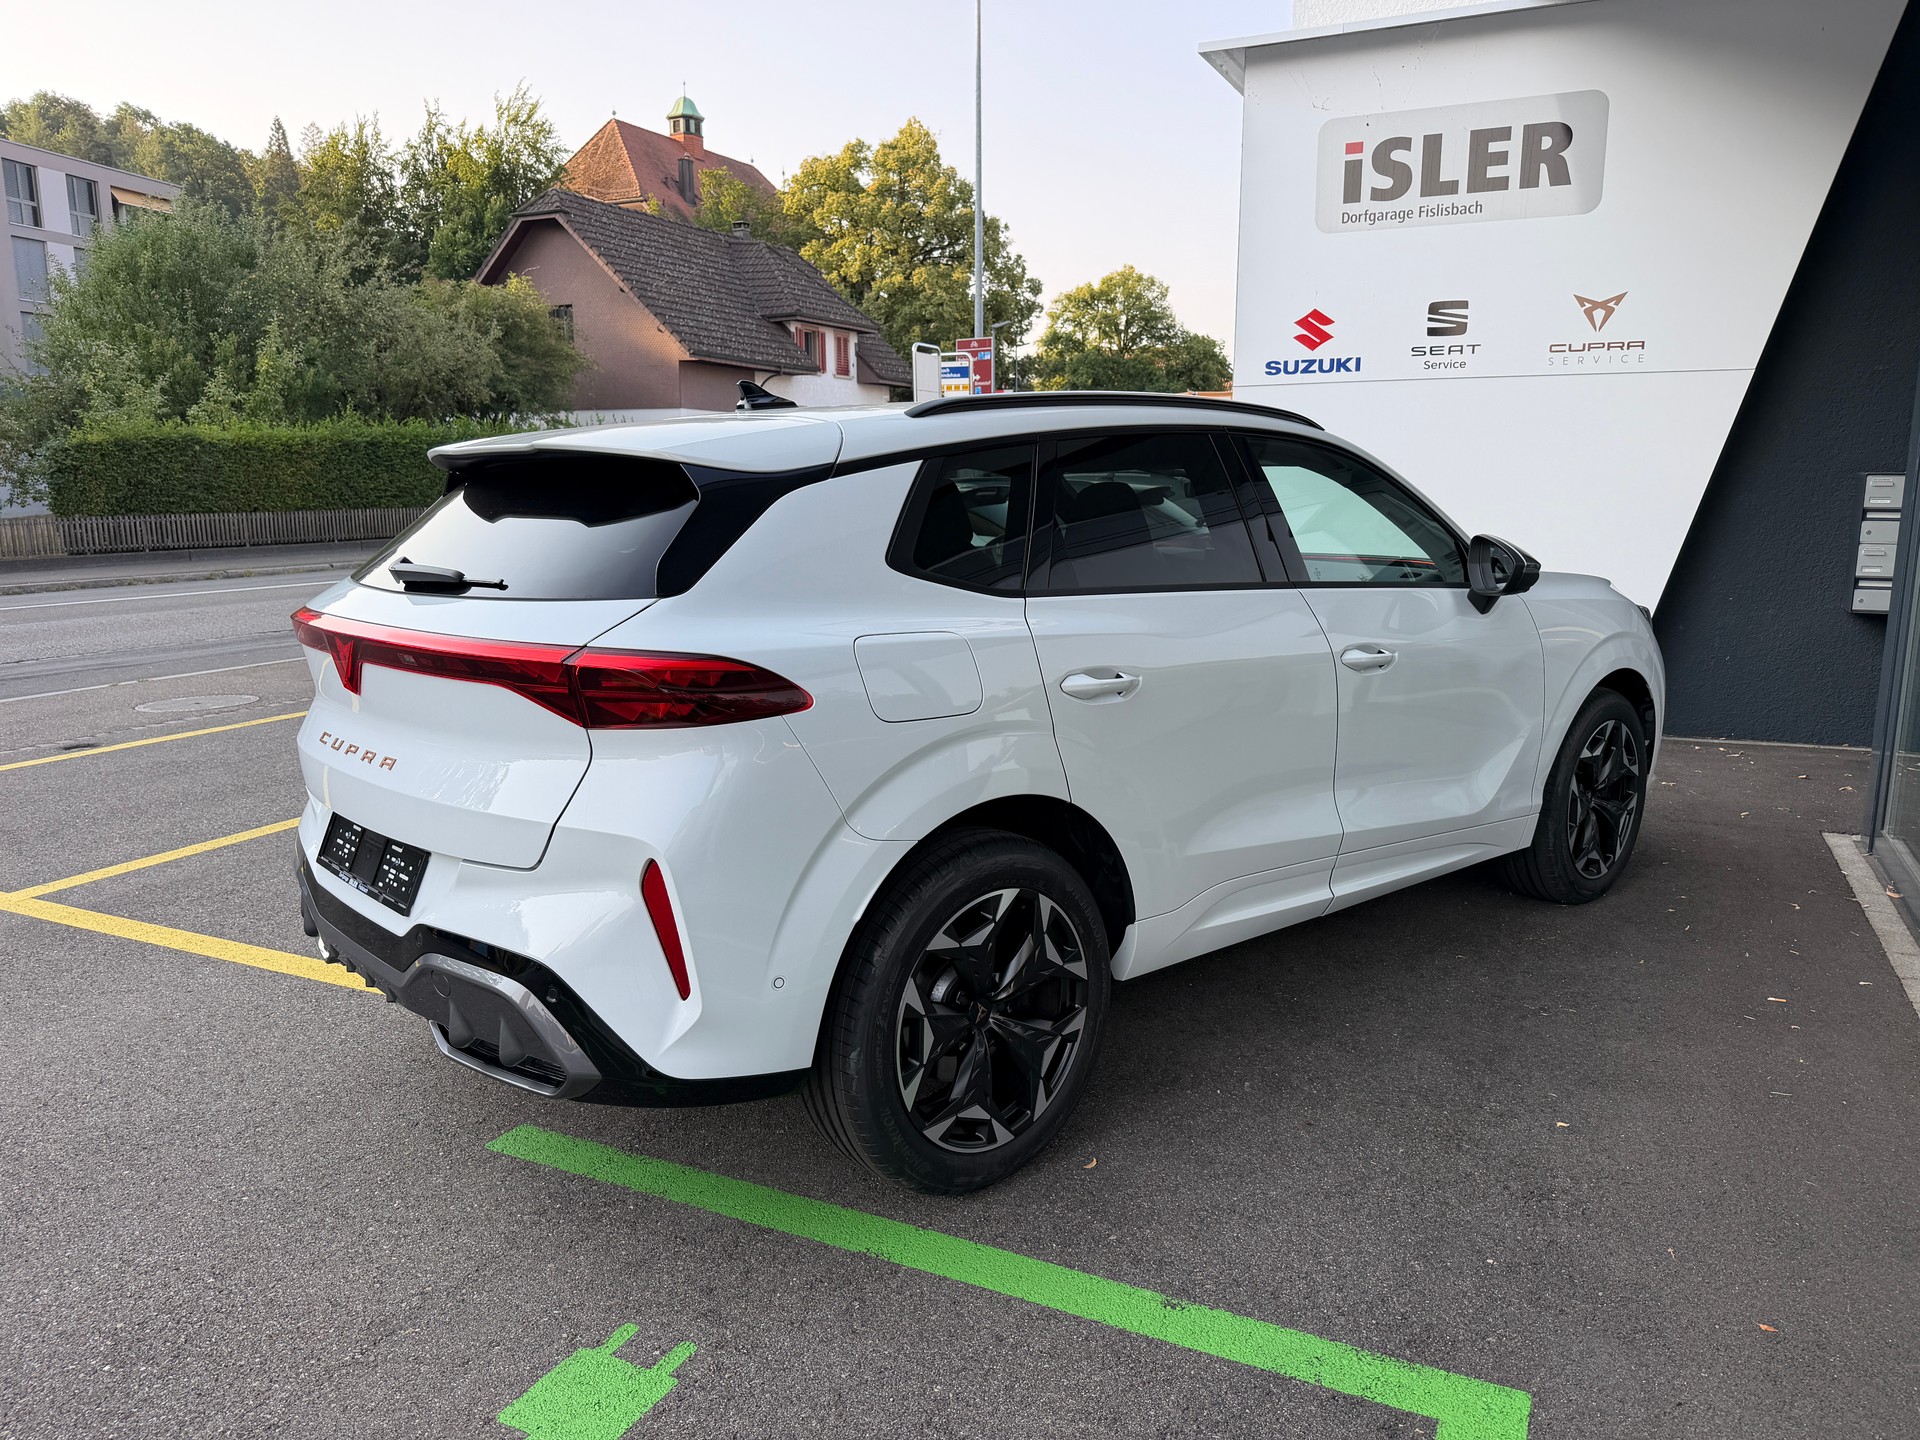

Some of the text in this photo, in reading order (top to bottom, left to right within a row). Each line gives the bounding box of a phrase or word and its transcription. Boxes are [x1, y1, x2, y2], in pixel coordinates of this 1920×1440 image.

[1341, 201, 1483, 225] Dorfgarage Fislisbach
[1411, 344, 1482, 357] SEAT
[1549, 340, 1646, 353] CUPRA
[1265, 356, 1362, 376] SUZUKI
[1423, 359, 1467, 370] Service
[1548, 353, 1645, 366] SERVICE
[319, 731, 397, 771] CUPRA
